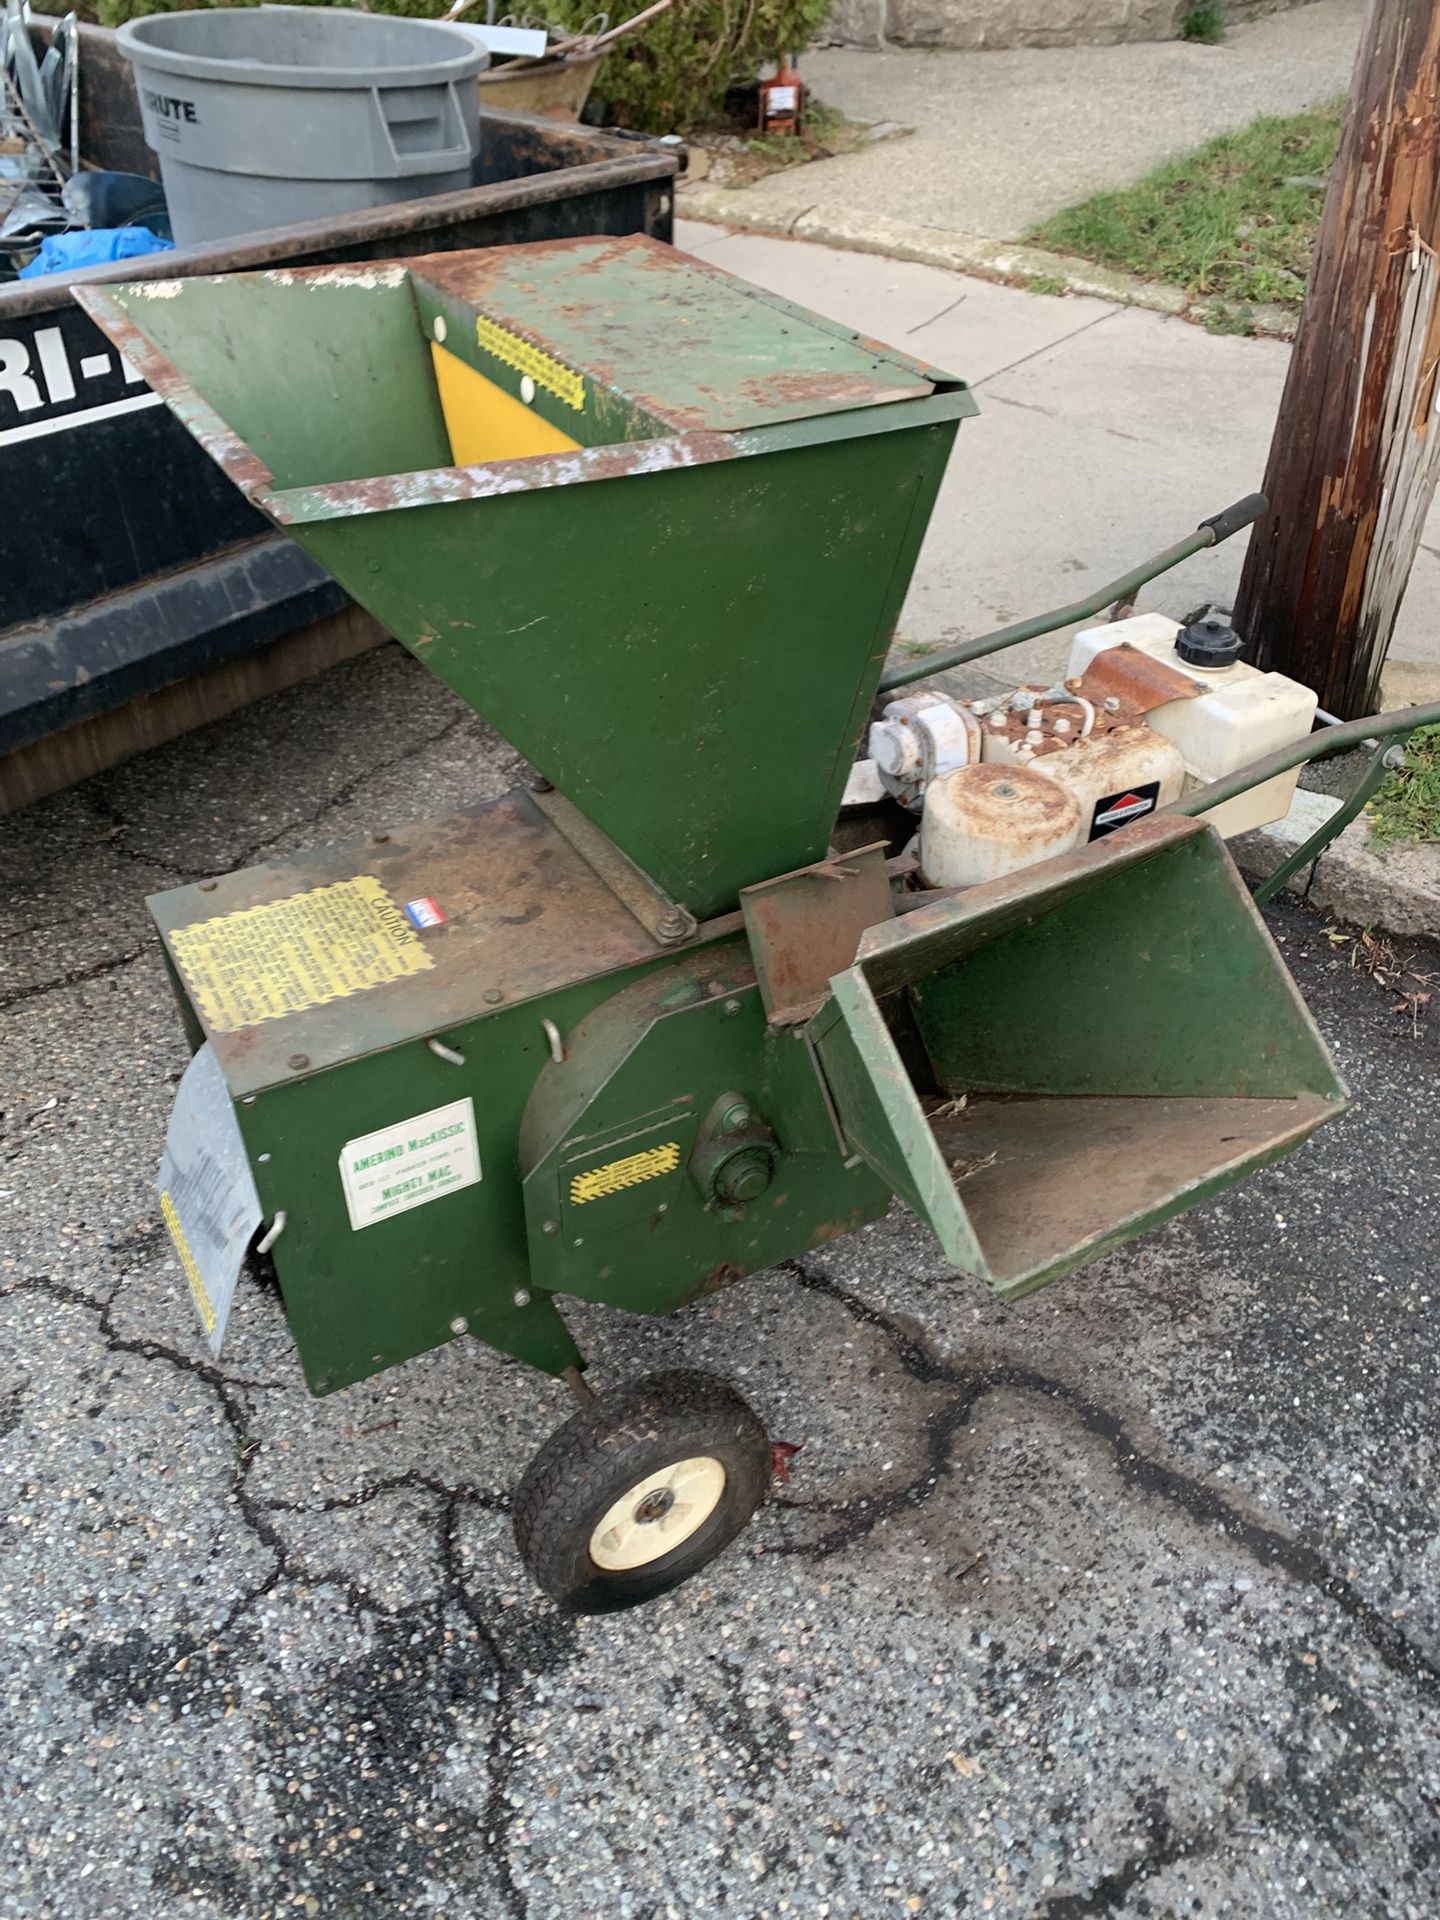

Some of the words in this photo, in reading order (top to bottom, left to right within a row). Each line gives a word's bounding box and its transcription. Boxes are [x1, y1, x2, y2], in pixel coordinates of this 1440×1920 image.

[142, 89, 197, 123] RUTE
[0, 326, 144, 412] RI-
[371, 897, 414, 947] CAUTION
[382, 1176, 423, 1200] MIGHTY
[428, 1164, 452, 1182] MAC
